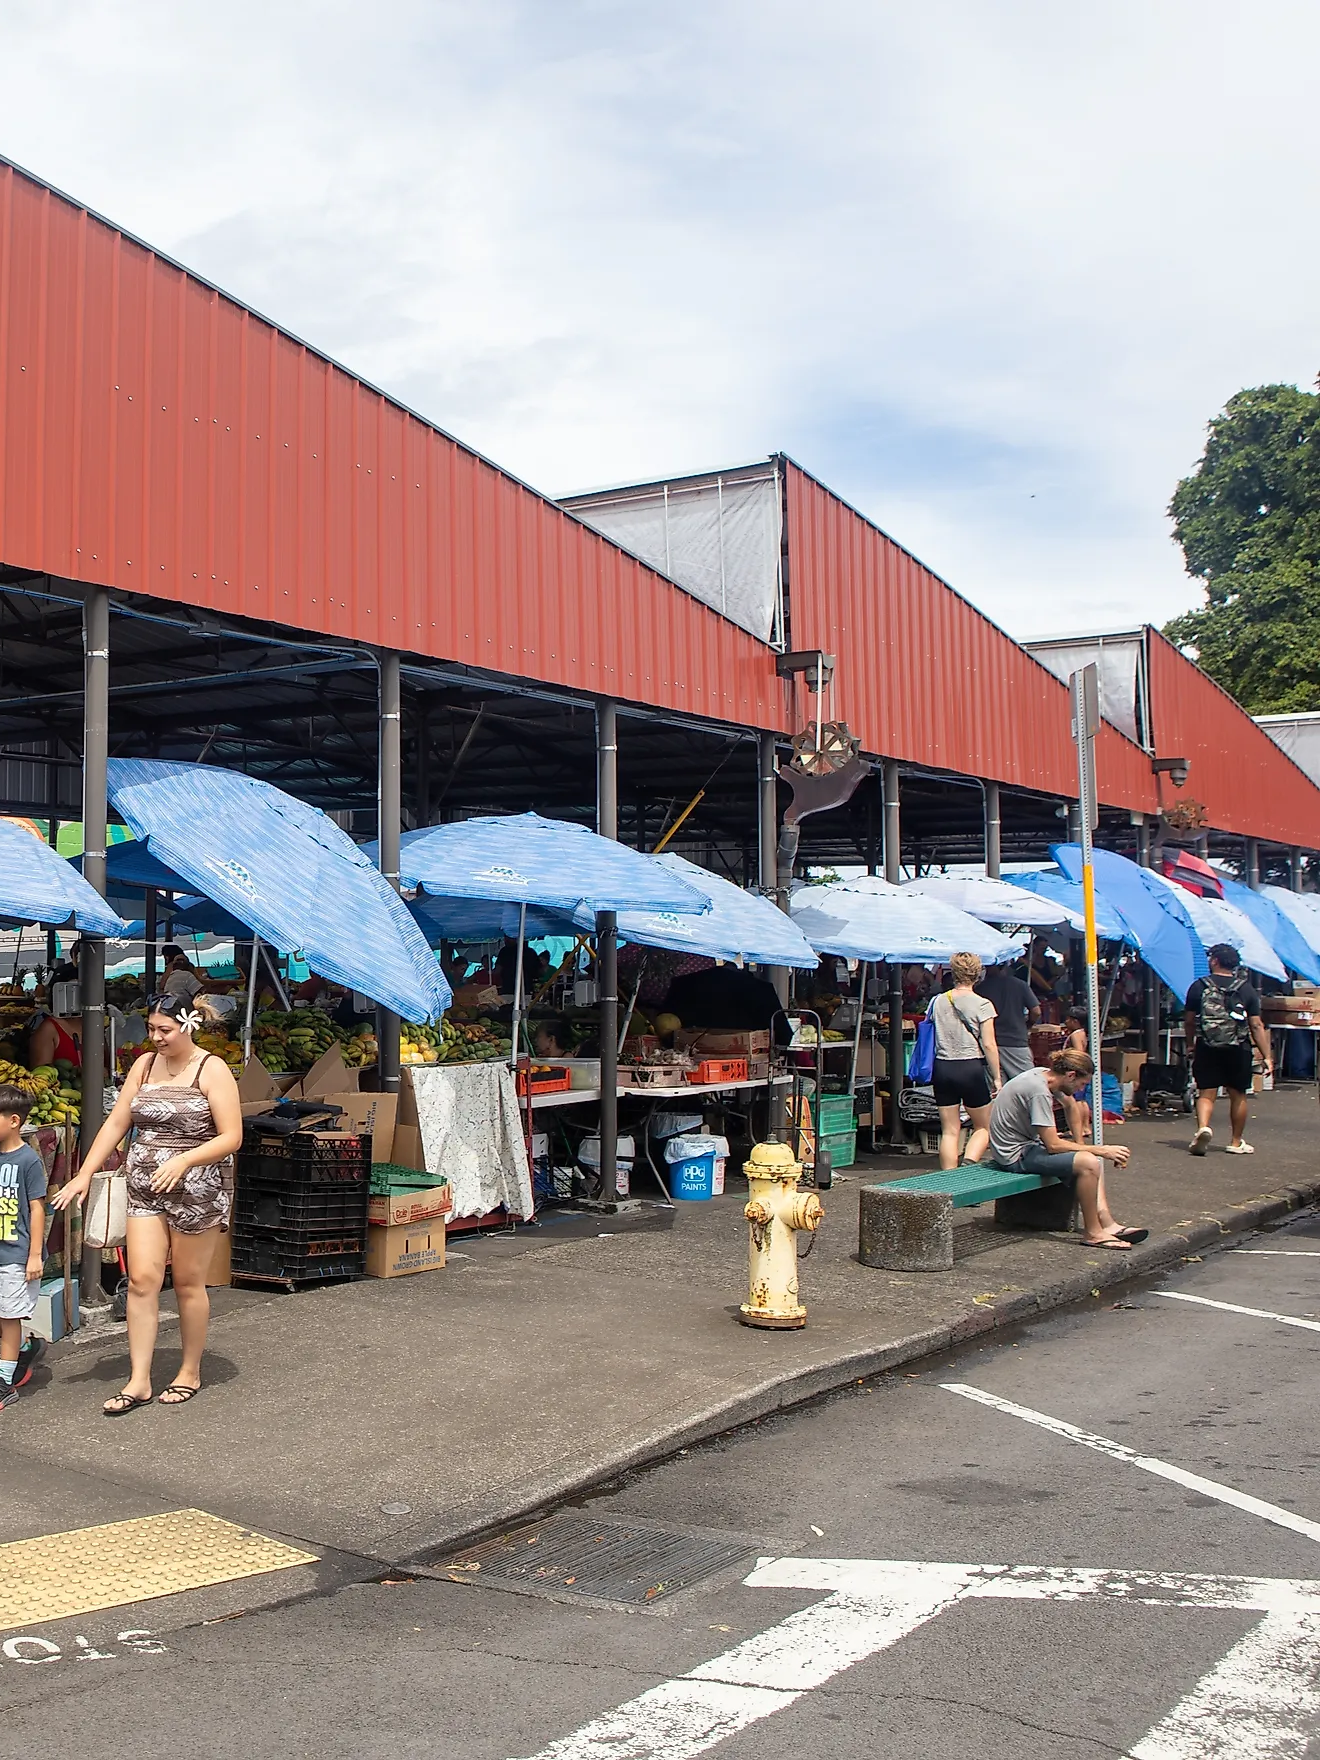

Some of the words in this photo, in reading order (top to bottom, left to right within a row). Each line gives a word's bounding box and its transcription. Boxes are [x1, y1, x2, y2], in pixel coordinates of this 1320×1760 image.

[682, 1183, 707, 1191] PAINTS
[396, 1209, 408, 1219] Dole
[399, 1252, 421, 1261] BANANA
[421, 1249, 436, 1258] APPLE
[432, 1256, 441, 1264] BIG
